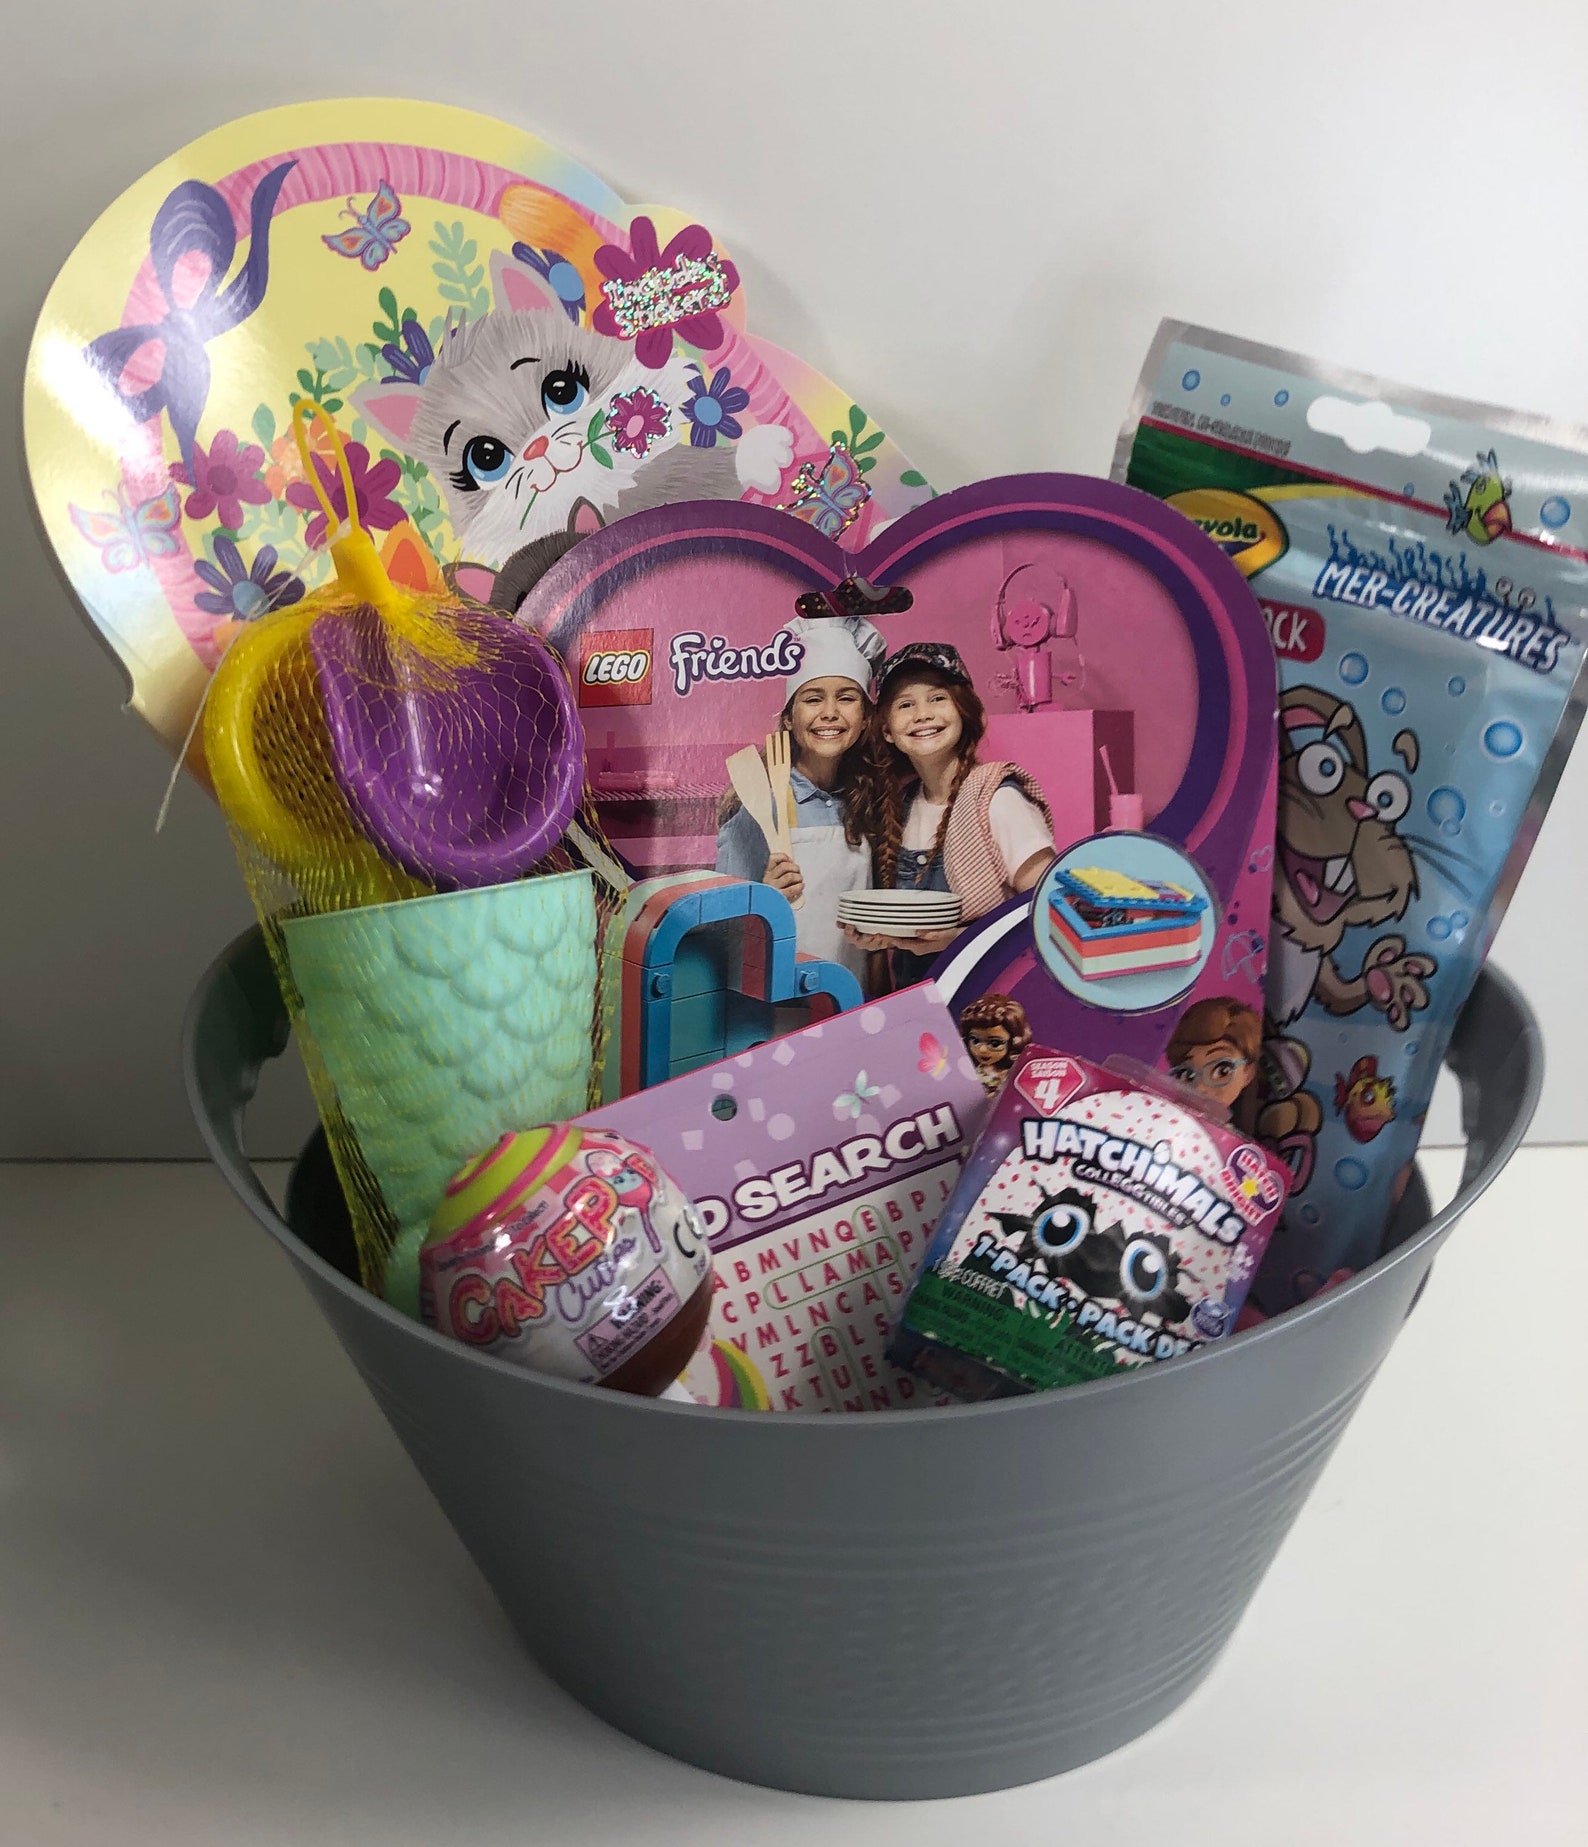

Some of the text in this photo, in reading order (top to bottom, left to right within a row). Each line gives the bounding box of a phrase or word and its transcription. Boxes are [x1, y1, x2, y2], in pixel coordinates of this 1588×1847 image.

[1316, 562, 1569, 670] MER-CREATURES
[585, 633, 802, 692] LEGO Friends
[1033, 1078, 1061, 1110] 4
[734, 1104, 962, 1221] SEARCH
[1076, 1301, 1157, 1354] PACK
